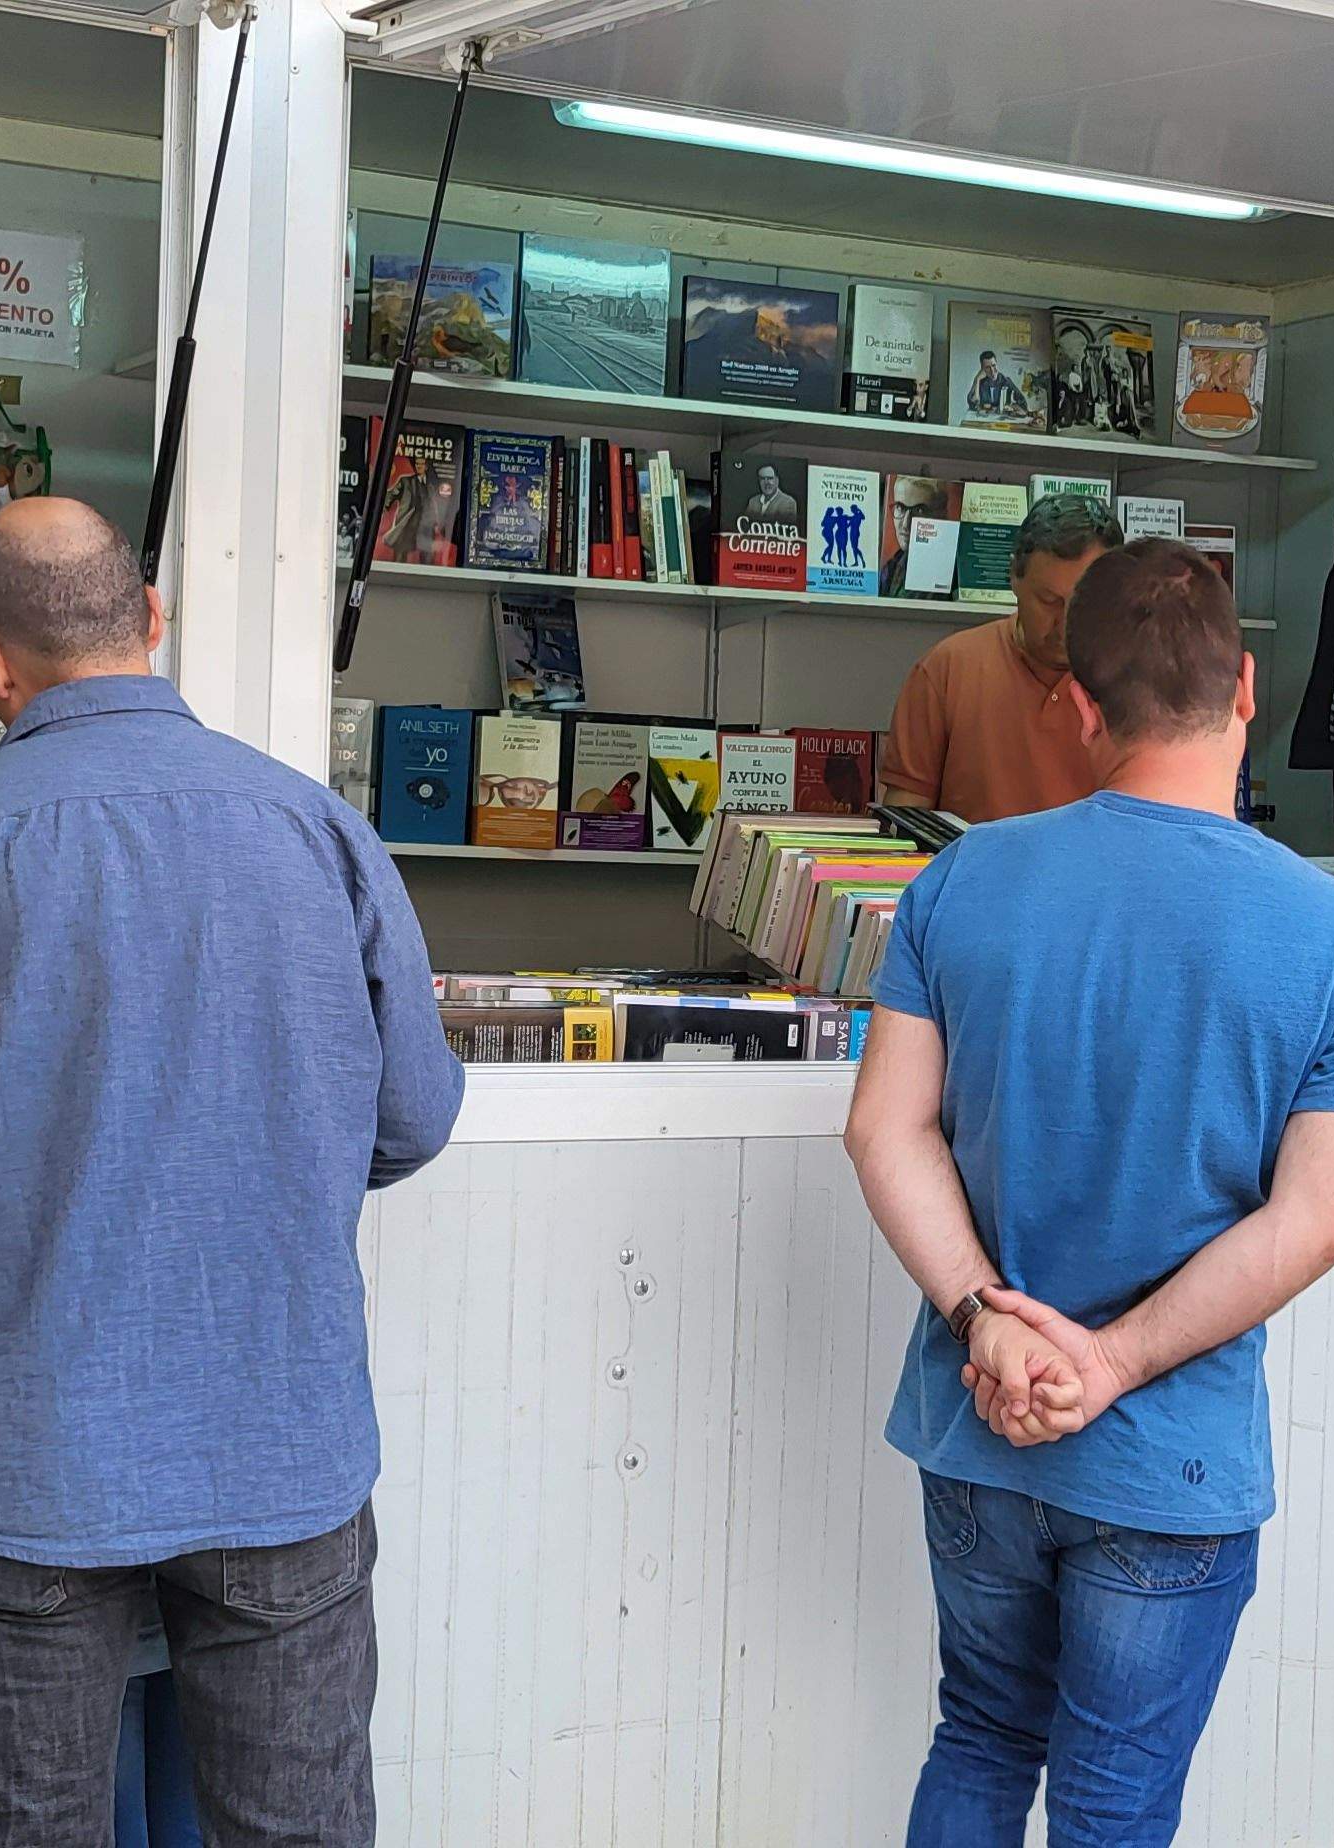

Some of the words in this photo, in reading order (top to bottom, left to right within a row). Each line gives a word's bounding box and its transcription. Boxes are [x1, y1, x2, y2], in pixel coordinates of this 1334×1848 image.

[14, 327, 55, 338] TARJETA
[865, 335, 880, 347] De
[882, 338, 924, 352] animales
[875, 354, 881, 362] a
[884, 353, 912, 365] dioses
[397, 434, 453, 449] AUDILLO
[395, 446, 453, 462] ÁNCHEZ
[487, 453, 515, 463] ELVIRA
[821, 481, 867, 493] NUESTRO
[1043, 480, 1061, 492] WILL
[1064, 482, 1108, 497] GOMPERTZ
[824, 490, 864, 502] CUERPO
[737, 516, 799, 539] Contra
[729, 533, 801, 557] Corriente
[821, 568, 831, 576] EL
[834, 570, 864, 579] MEJOR
[821, 578, 863, 587] ARSUAGA
[400, 719, 427, 733] ANIL
[428, 721, 460, 734] SETH
[651, 732, 679, 741] Carmen
[681, 733, 698, 742] Mola
[726, 743, 759, 753] VALTER
[760, 745, 792, 754] LONGO
[802, 737, 832, 754] HOLLY
[834, 738, 867, 755] BLACK
[426, 747, 448, 767] yo
[727, 771, 787, 785] AYUNO
[732, 789, 768, 798] CONTRA
[723, 800, 789, 813] CÁNCER
[837, 1021, 849, 1061] SARA
